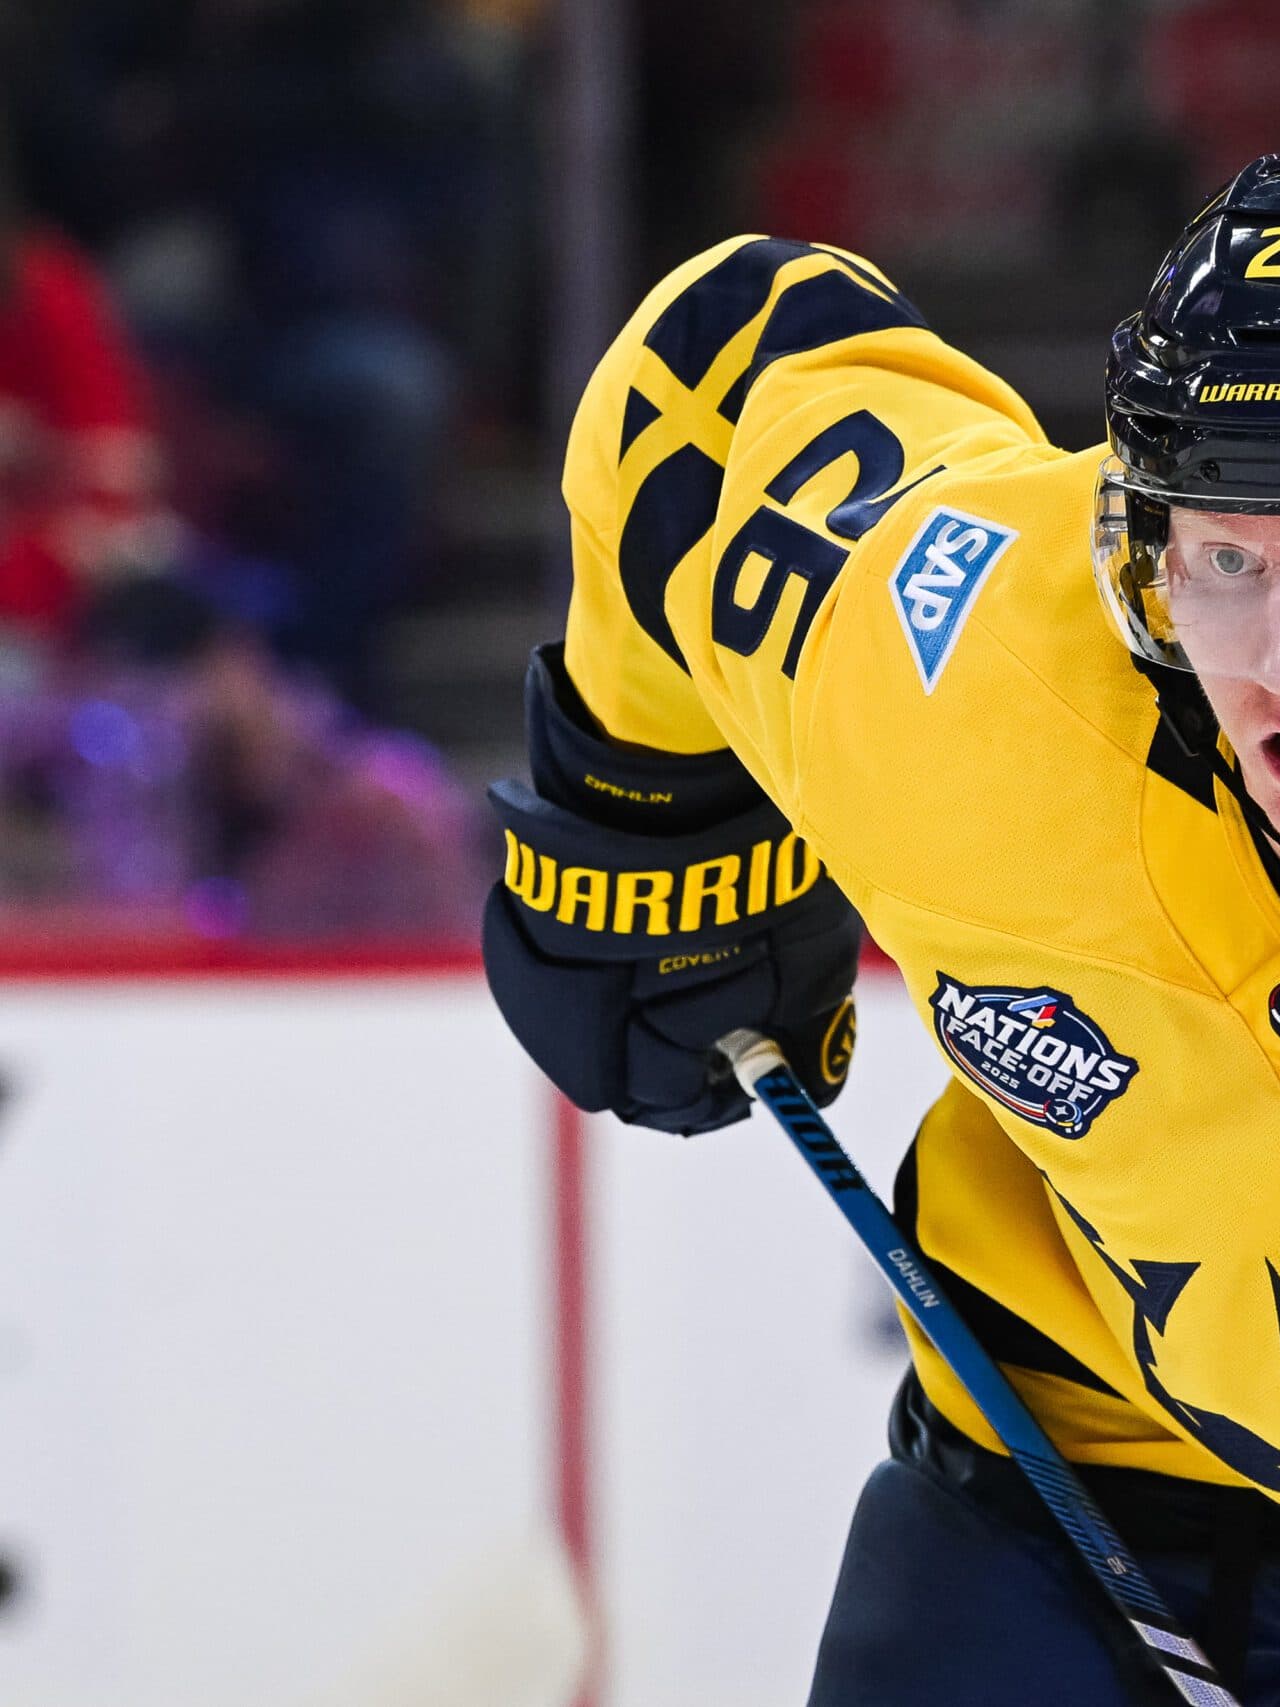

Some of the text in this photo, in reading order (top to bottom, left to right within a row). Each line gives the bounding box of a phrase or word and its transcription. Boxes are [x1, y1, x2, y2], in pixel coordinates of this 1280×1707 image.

[902, 519, 988, 631] SAP
[504, 828, 836, 936] WARRIO
[937, 983, 1130, 1091] NATIONS
[946, 1017, 1095, 1102] FACE-OFF
[981, 1060, 1020, 1090] 2025
[887, 1248, 940, 1308] DAHLIN
